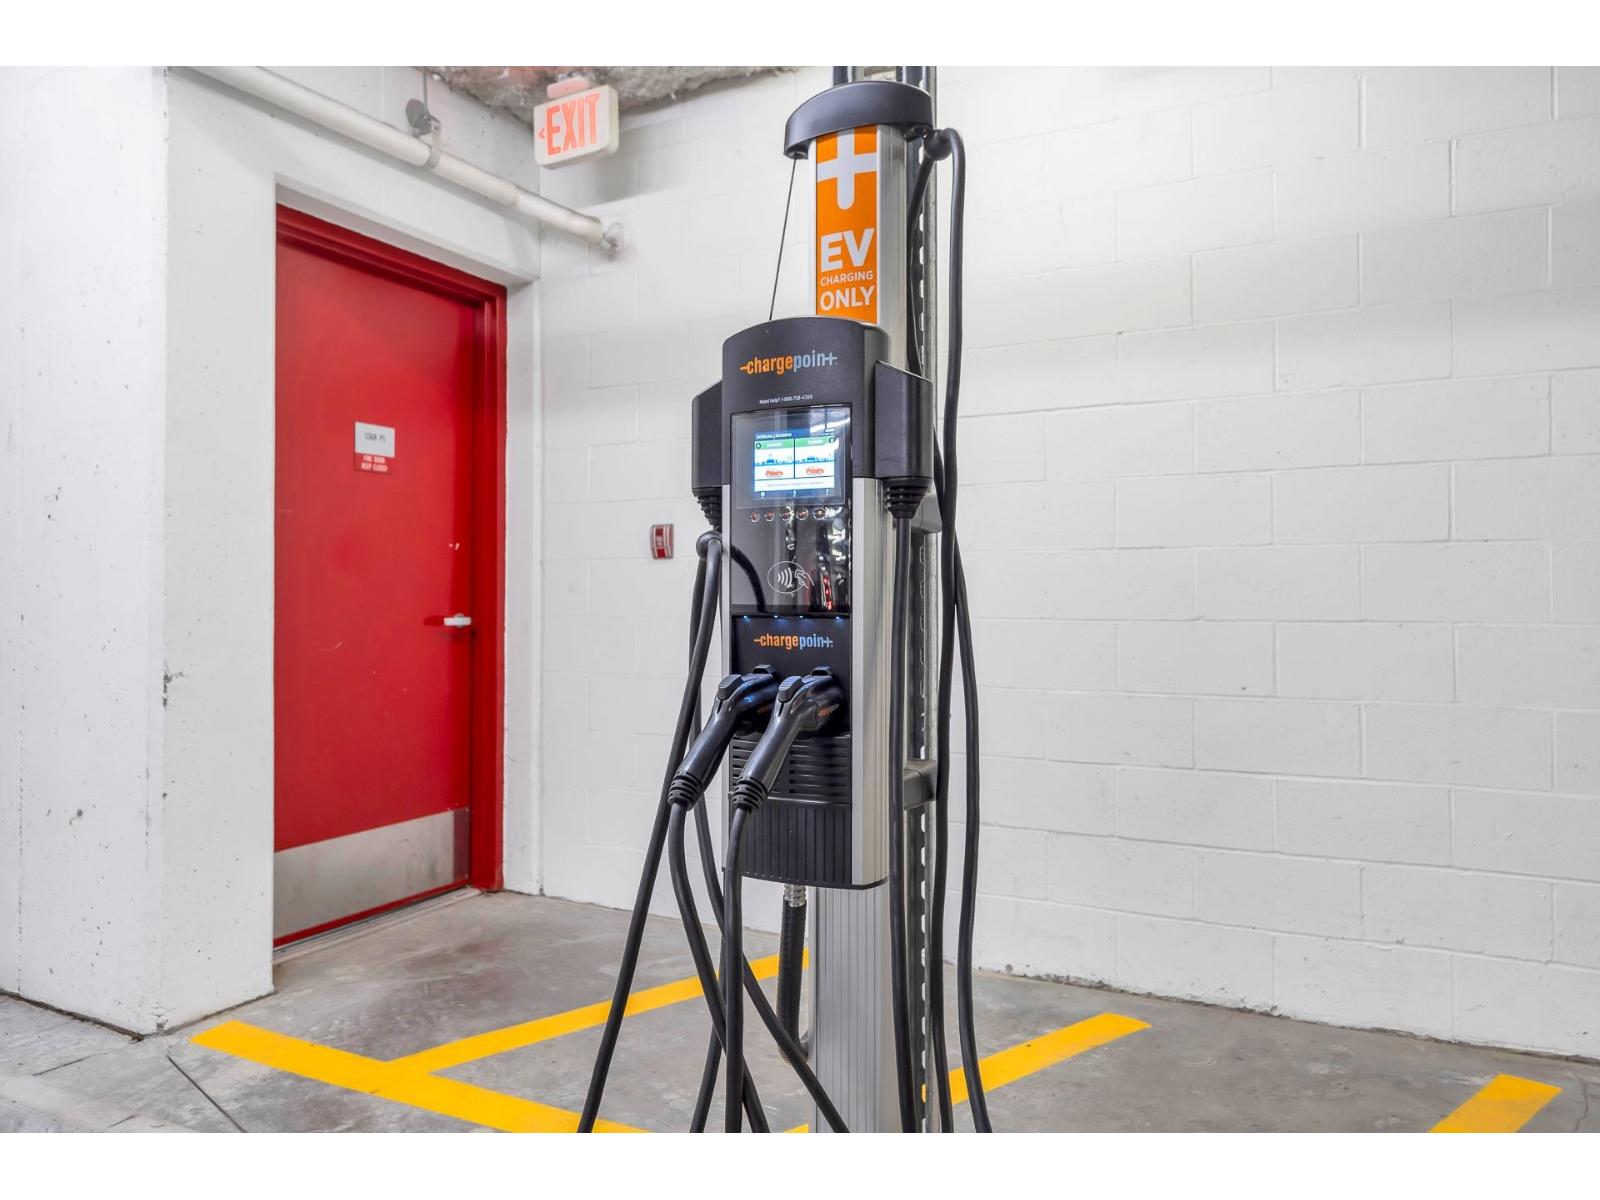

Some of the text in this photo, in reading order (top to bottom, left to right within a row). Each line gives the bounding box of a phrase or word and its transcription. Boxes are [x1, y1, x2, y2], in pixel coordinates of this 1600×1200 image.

[546, 93, 600, 155] EXIT
[820, 227, 875, 272] EV
[820, 271, 874, 287] CHARGING
[819, 285, 875, 311] ONLY
